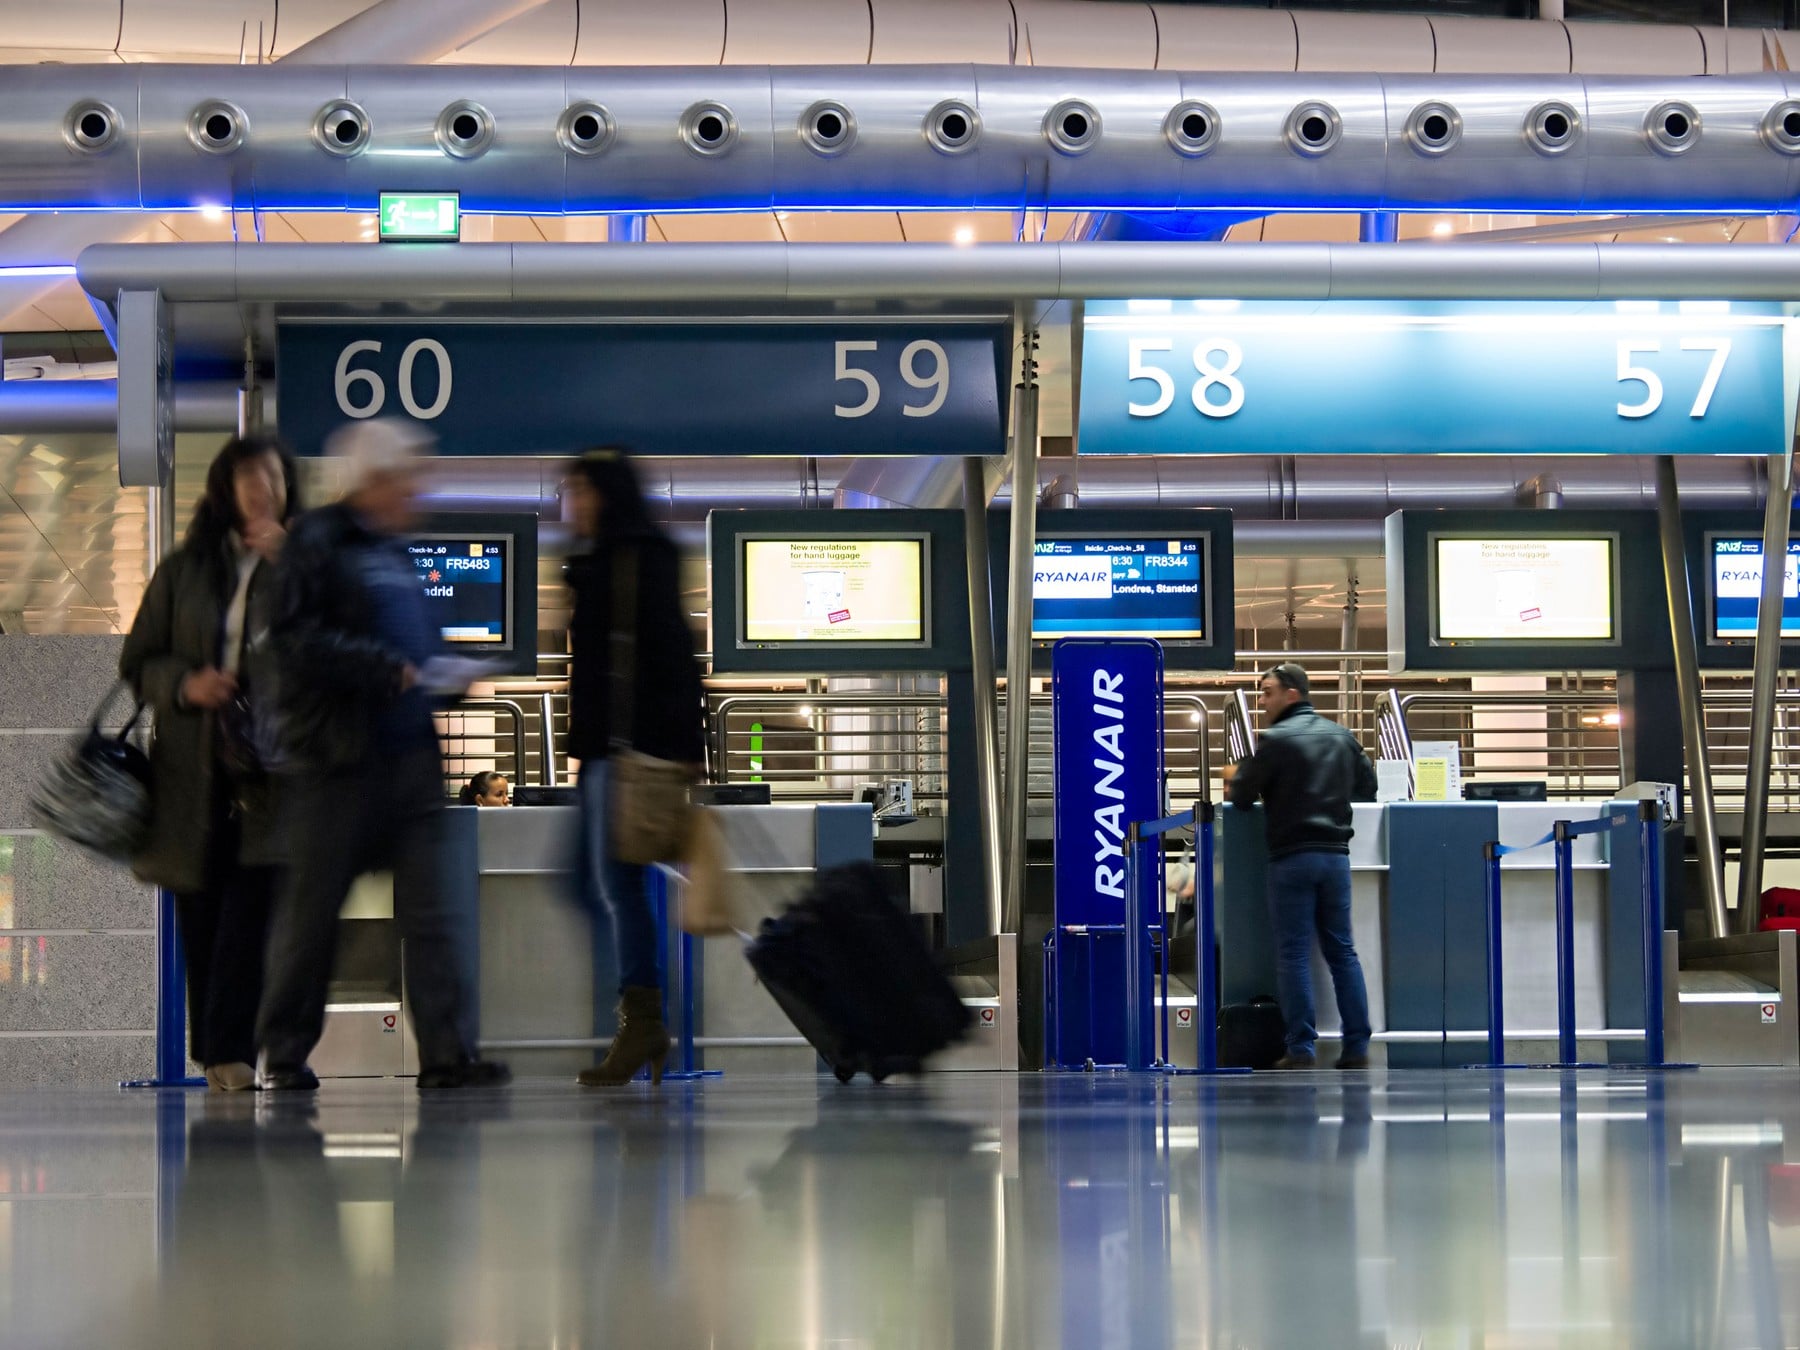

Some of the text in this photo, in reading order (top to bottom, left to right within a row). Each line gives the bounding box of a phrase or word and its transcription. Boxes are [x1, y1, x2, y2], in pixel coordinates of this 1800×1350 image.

[334, 338, 453, 420] 60
[834, 339, 950, 418] 59
[1127, 337, 1245, 418] 58
[1616, 337, 1732, 418] 57
[810, 543, 857, 552] regulations
[827, 552, 861, 560] luggage
[1145, 556, 1189, 567] FR8344
[446, 558, 490, 570] FR5483
[1034, 572, 1107, 582] RYANAIR
[1721, 571, 1793, 581] RYANR
[423, 585, 454, 597] adrid
[1112, 583, 1198, 595] Londres, Stansted
[1093, 668, 1126, 899] RYANAIR
